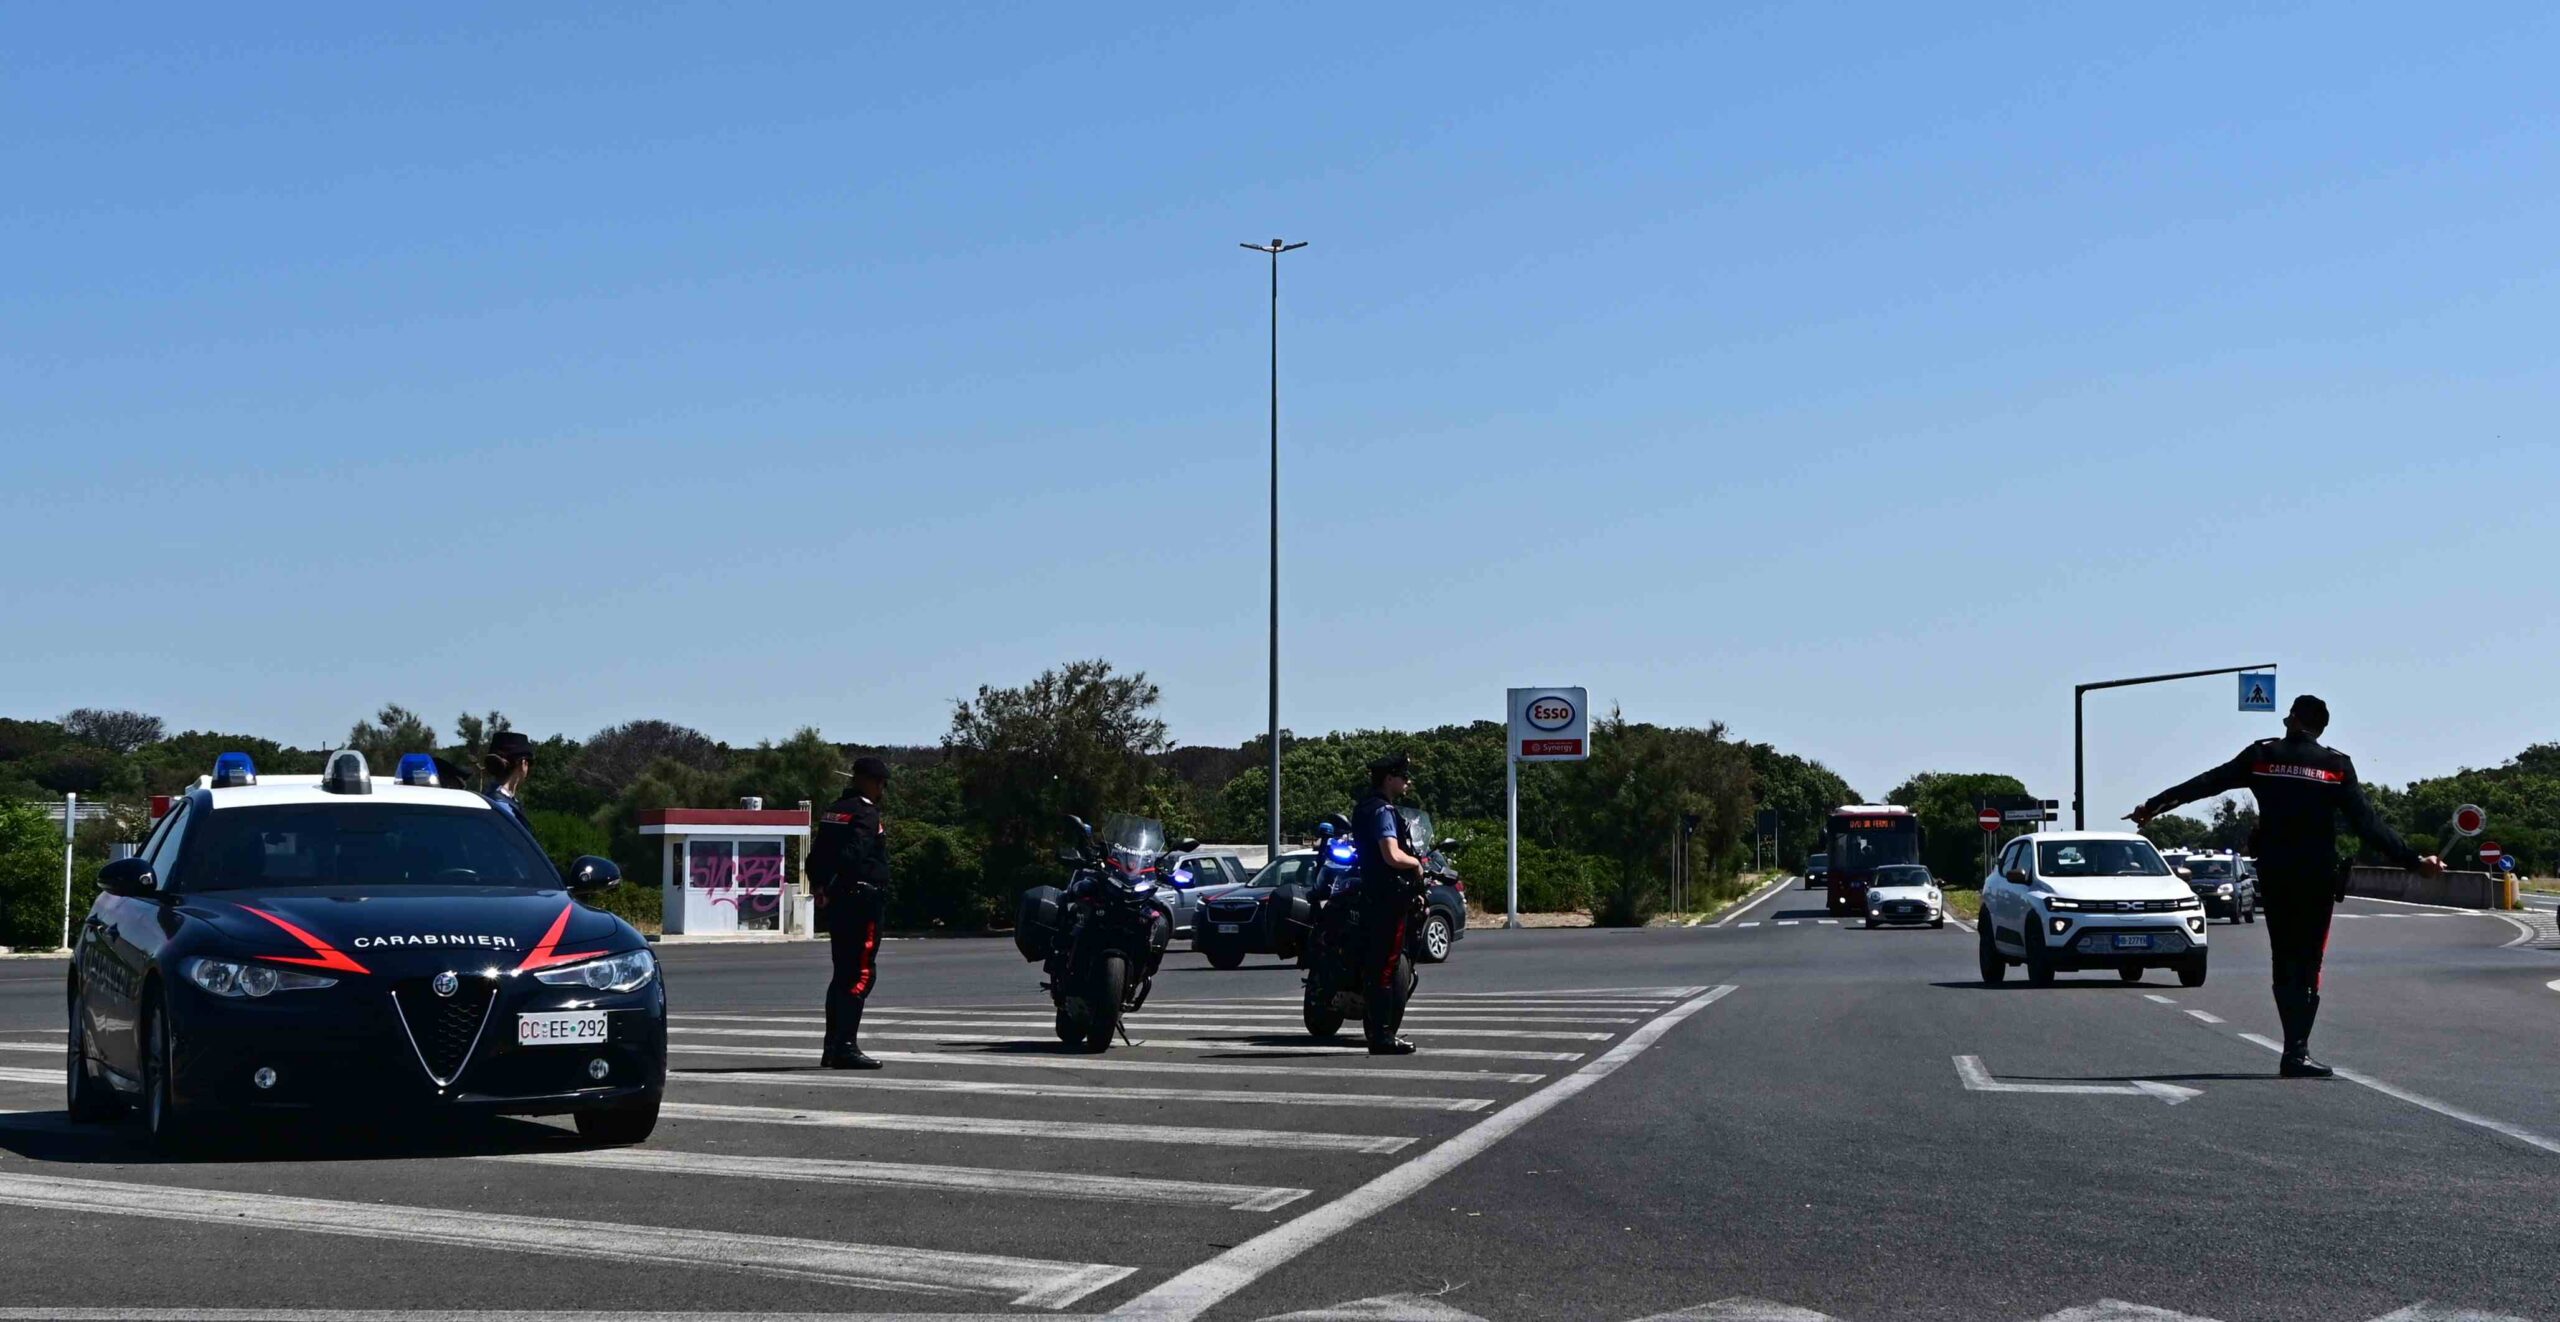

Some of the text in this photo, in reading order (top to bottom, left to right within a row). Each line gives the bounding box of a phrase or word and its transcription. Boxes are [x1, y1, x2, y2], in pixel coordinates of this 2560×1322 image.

[1534, 705, 1569, 719] Esso
[1543, 743, 1573, 752] Synergy
[2268, 763, 2326, 780] CARABINIERI
[354, 934, 516, 948] CARABINIERI
[578, 1019, 606, 1037] 292
